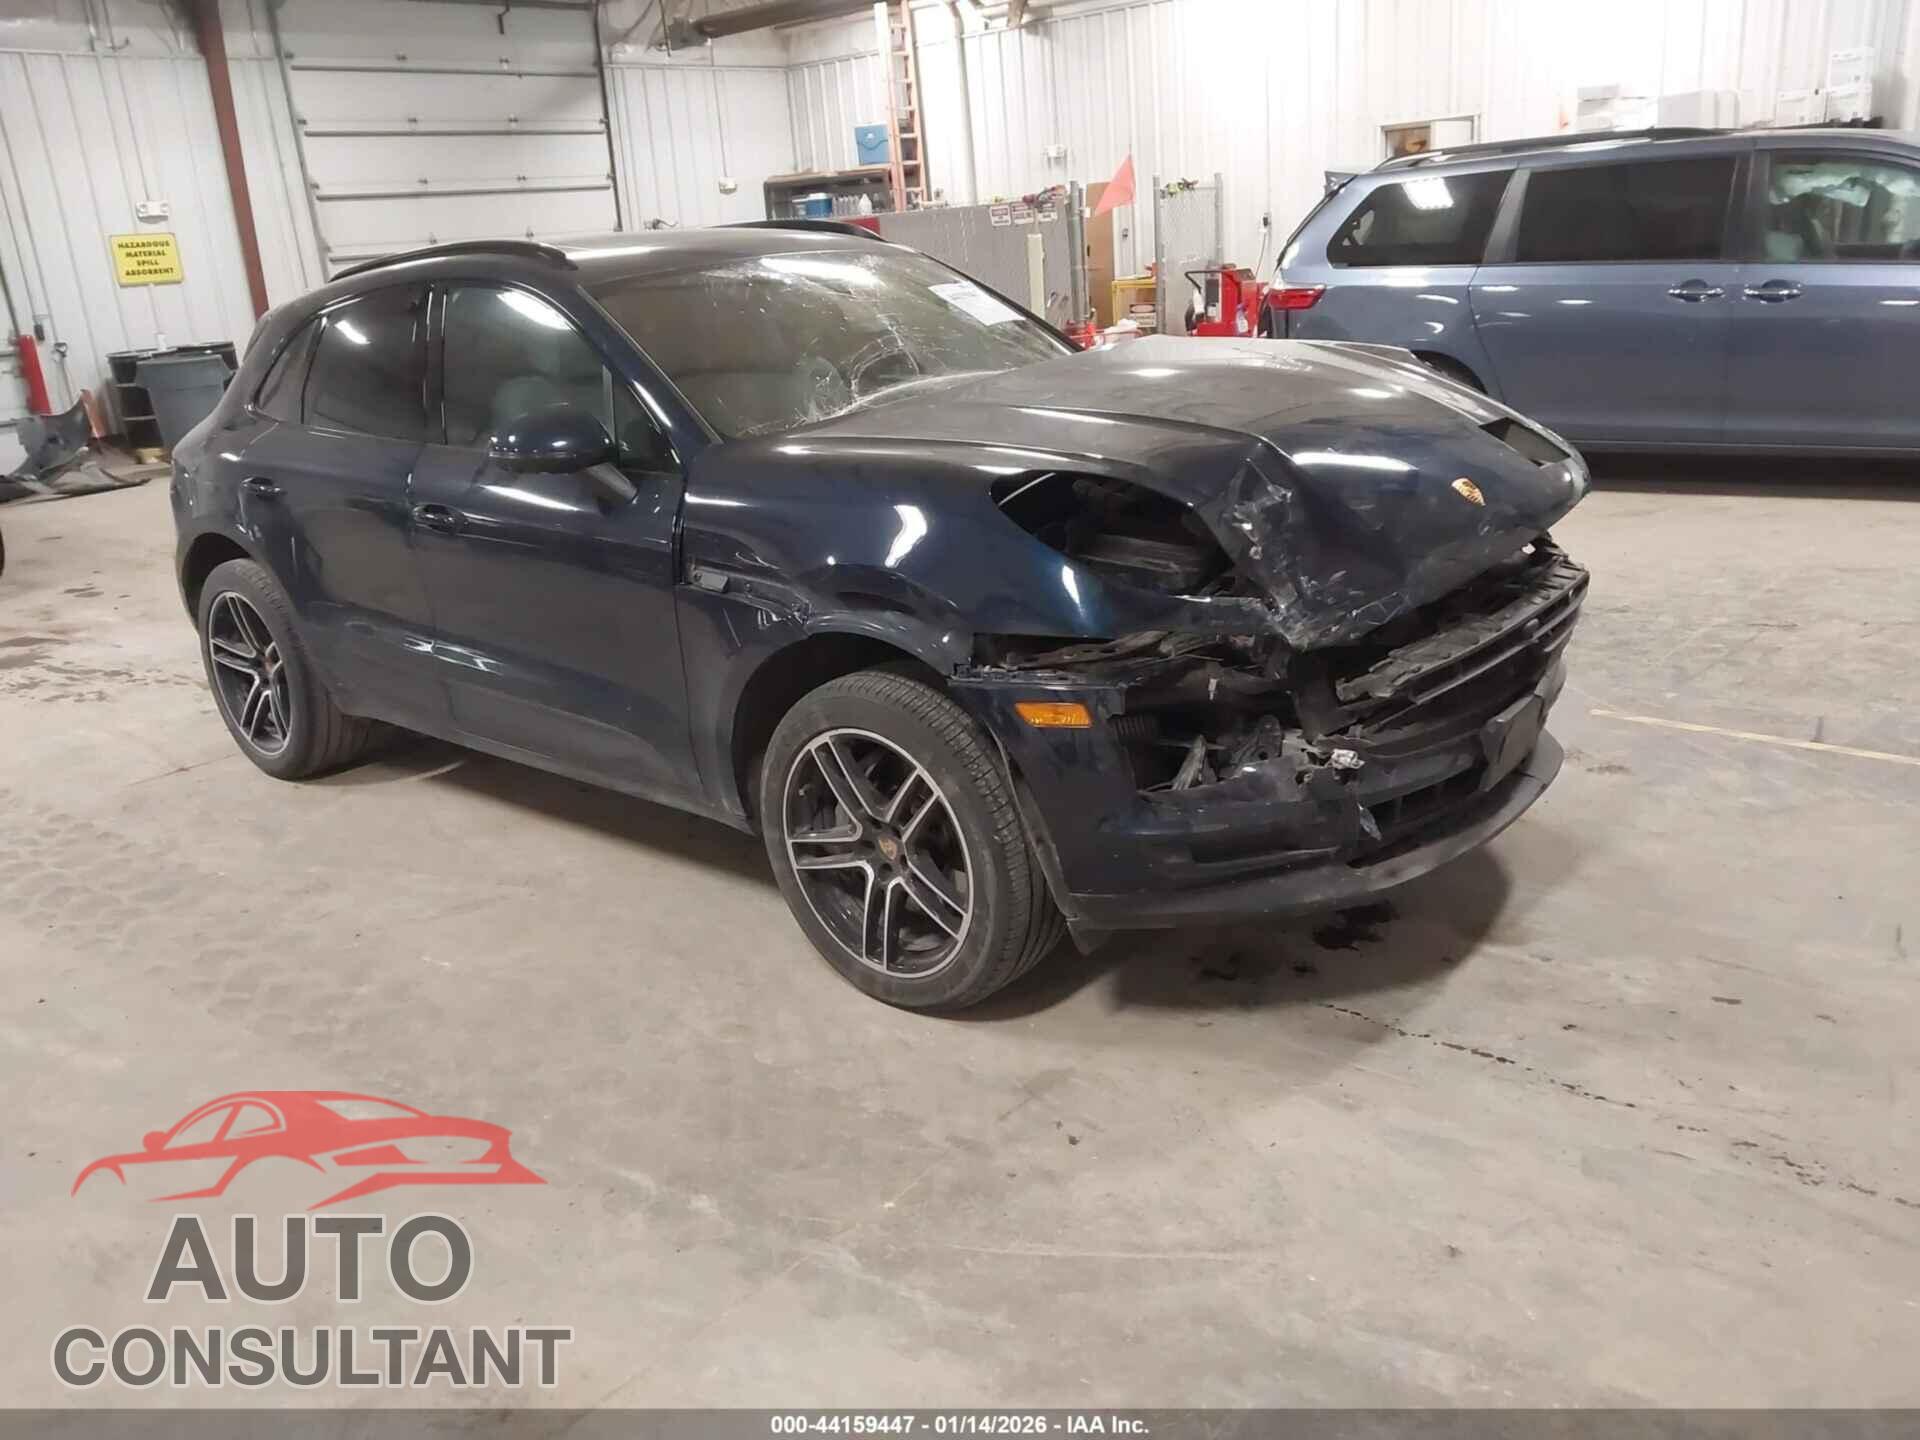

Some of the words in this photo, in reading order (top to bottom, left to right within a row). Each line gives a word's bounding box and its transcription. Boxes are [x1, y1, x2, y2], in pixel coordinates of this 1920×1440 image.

[118, 240, 170, 249] HAZARDOUS
[125, 249, 167, 258] MATERIAL
[136, 259, 160, 267] SPILL
[125, 267, 174, 276] ABSORBENT
